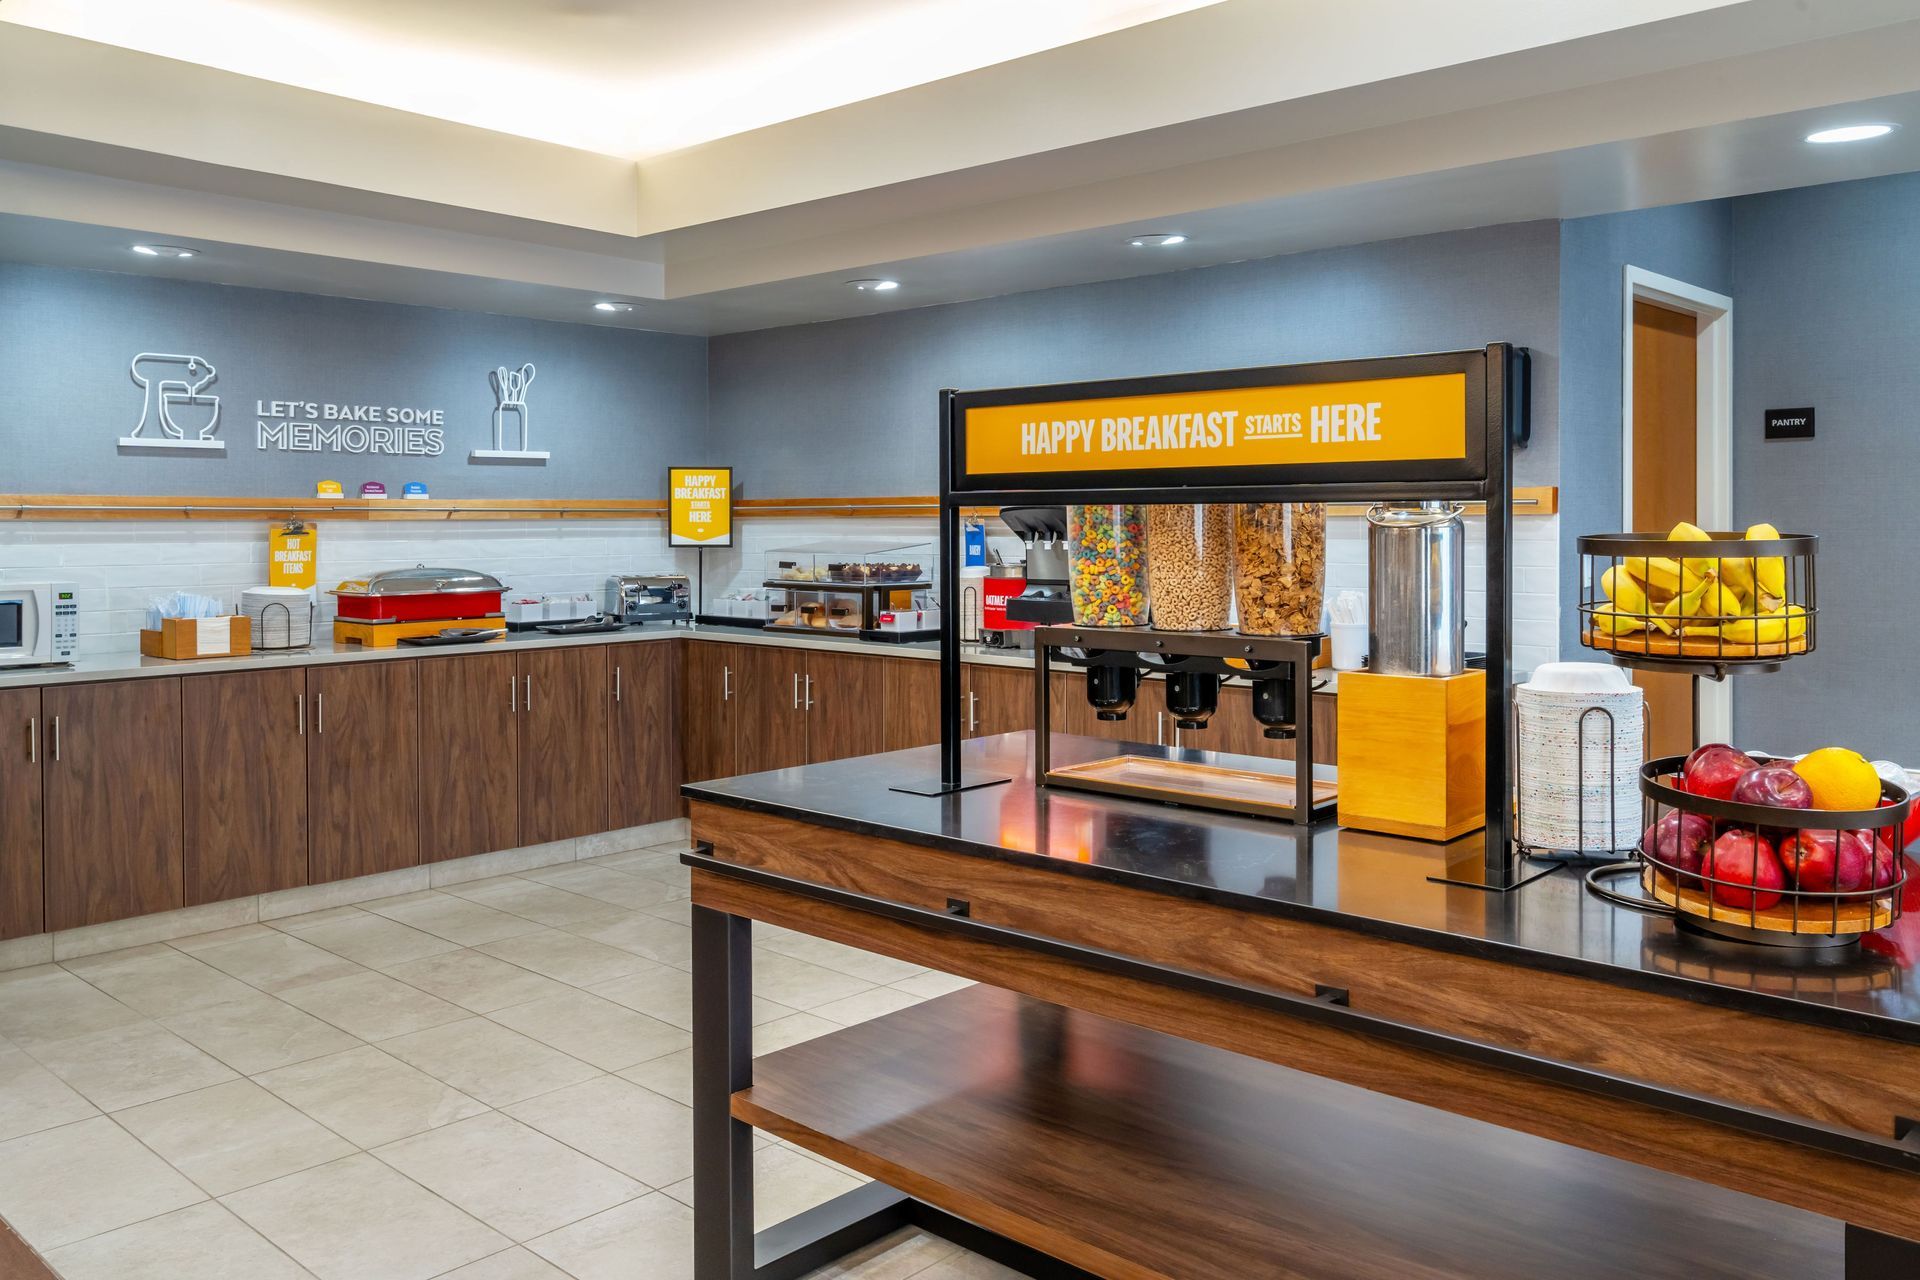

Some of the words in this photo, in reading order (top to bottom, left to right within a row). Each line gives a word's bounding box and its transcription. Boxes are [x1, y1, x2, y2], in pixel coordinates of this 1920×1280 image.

[257, 400, 318, 419] LET'S
[323, 403, 382, 422] BAKE
[386, 407, 445, 425] SOME
[1021, 419, 1095, 455] HAPPY
[1101, 411, 1238, 452] BREAKFAST
[1245, 413, 1302, 434] STARTS
[1310, 402, 1382, 443] HERE
[1771, 418, 1806, 427] PANTRY
[257, 421, 445, 455] MEMORIES
[684, 475, 716, 487] HAPPY
[674, 487, 726, 499] BREAKFAST
[689, 511, 712, 523] HERE
[287, 538, 301, 550] HOT
[274, 550, 312, 562] BREAKFAST
[283, 562, 304, 574] ITEMS
[985, 595, 1012, 606] OATMEA
